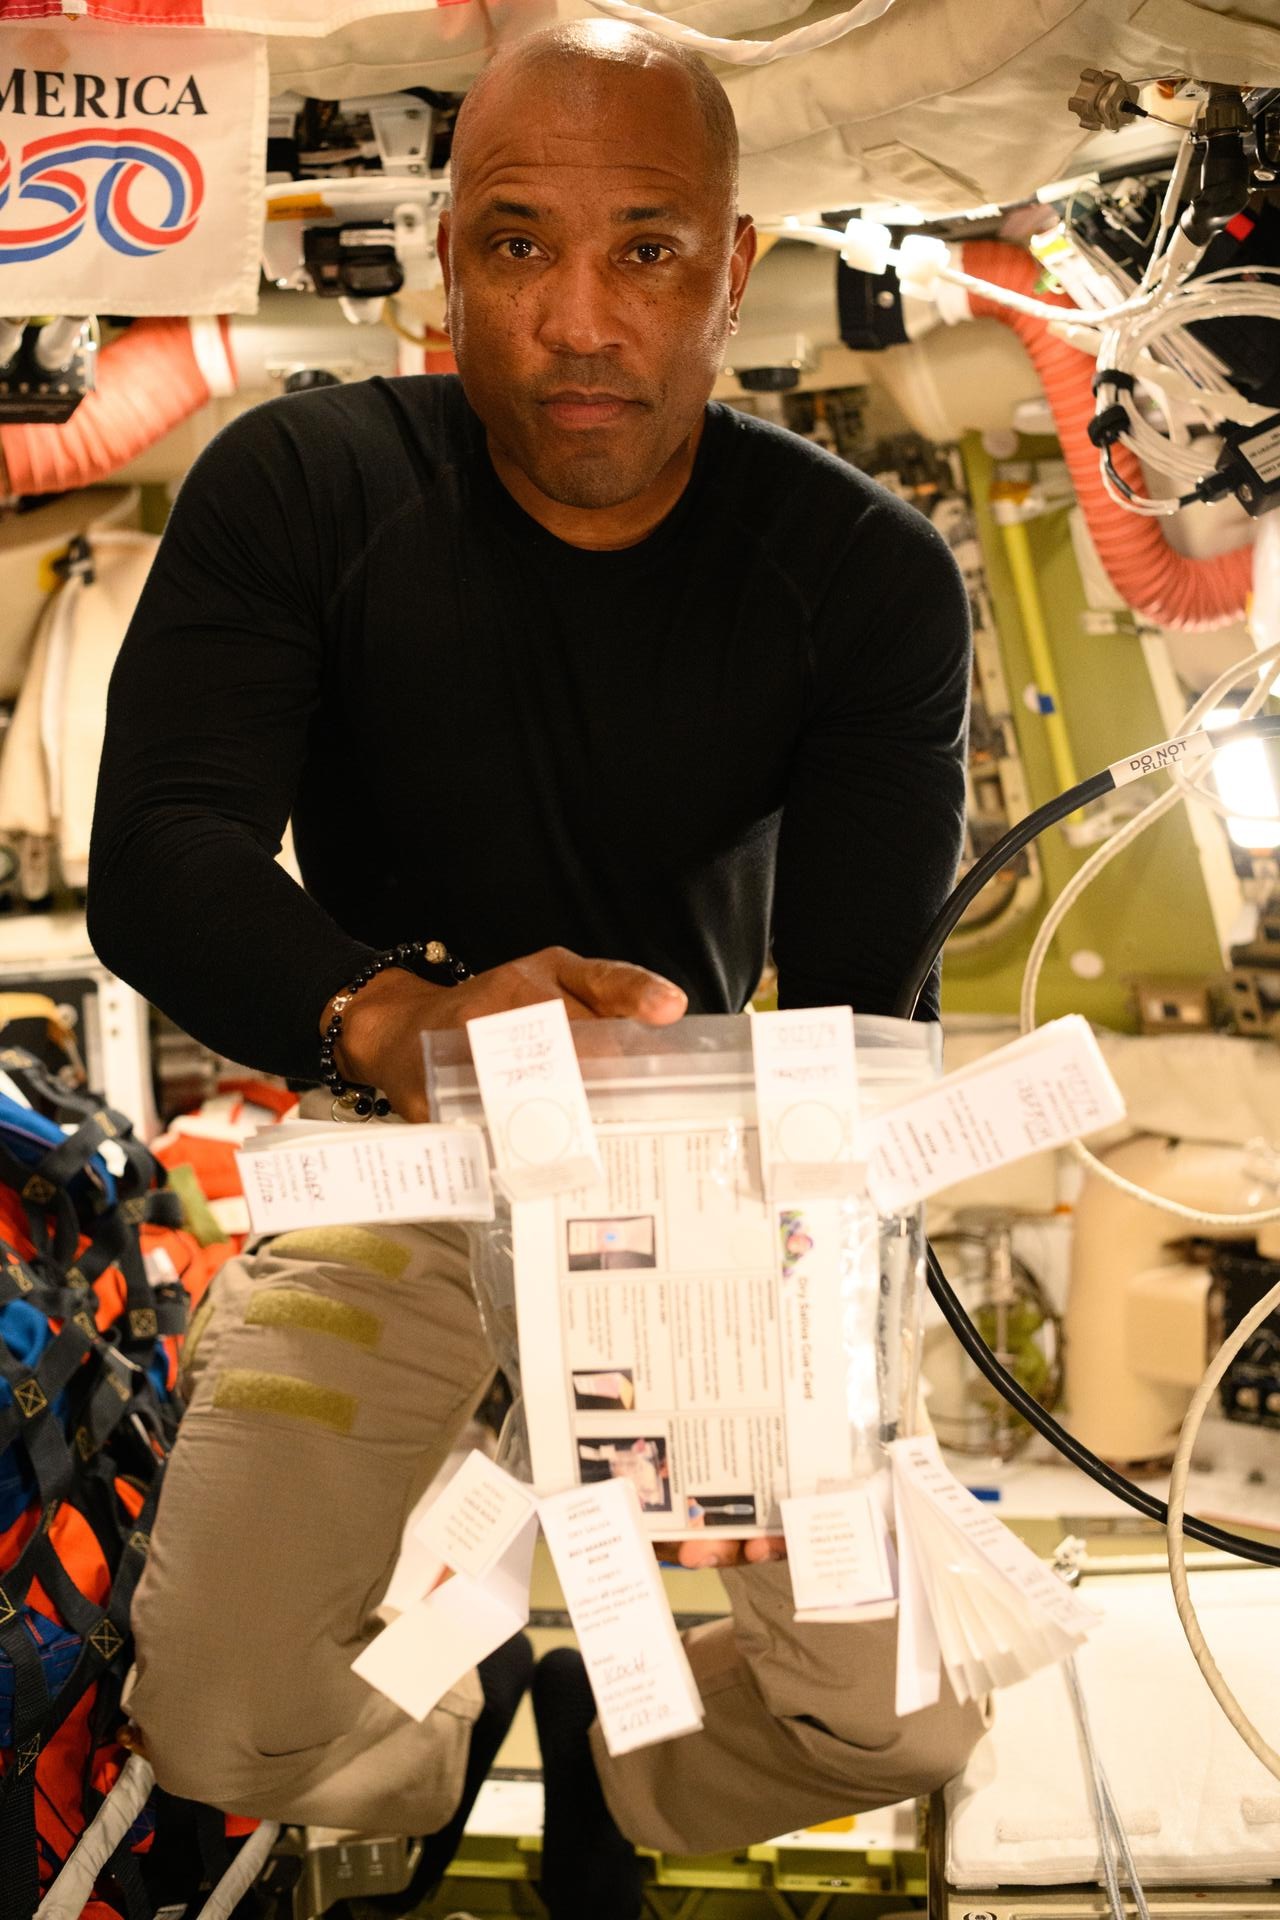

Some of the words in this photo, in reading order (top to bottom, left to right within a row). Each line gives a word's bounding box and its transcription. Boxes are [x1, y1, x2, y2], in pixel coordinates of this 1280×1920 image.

[0, 127, 205, 264] 50
[1129, 755, 1152, 771] DO
[1156, 740, 1187, 761] NOT
[1142, 755, 1182, 774] PULL
